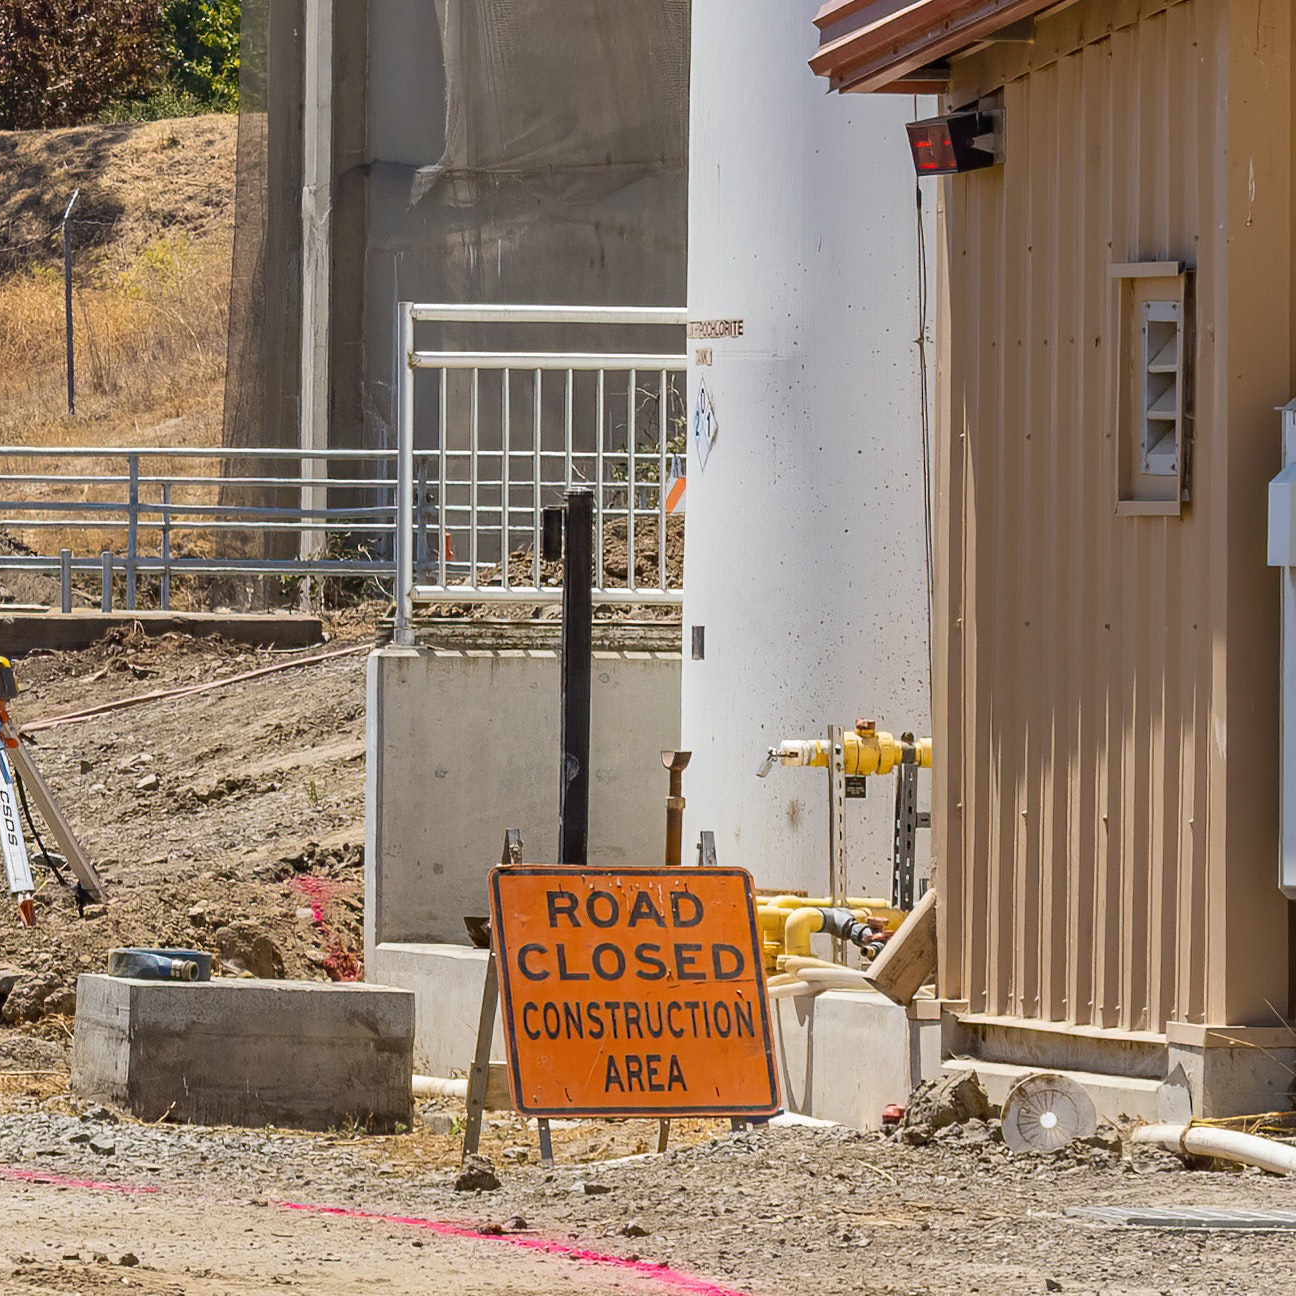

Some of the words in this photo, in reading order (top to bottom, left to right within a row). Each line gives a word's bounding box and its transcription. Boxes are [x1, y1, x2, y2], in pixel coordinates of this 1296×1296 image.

[700, 388, 706, 414] 0
[0, 790, 18, 846] CSDS
[546, 890, 705, 929] ROAD
[517, 943, 746, 981] CLOSED
[522, 1000, 756, 1040] CONSTRUCTION
[604, 1054, 688, 1093] AREA
